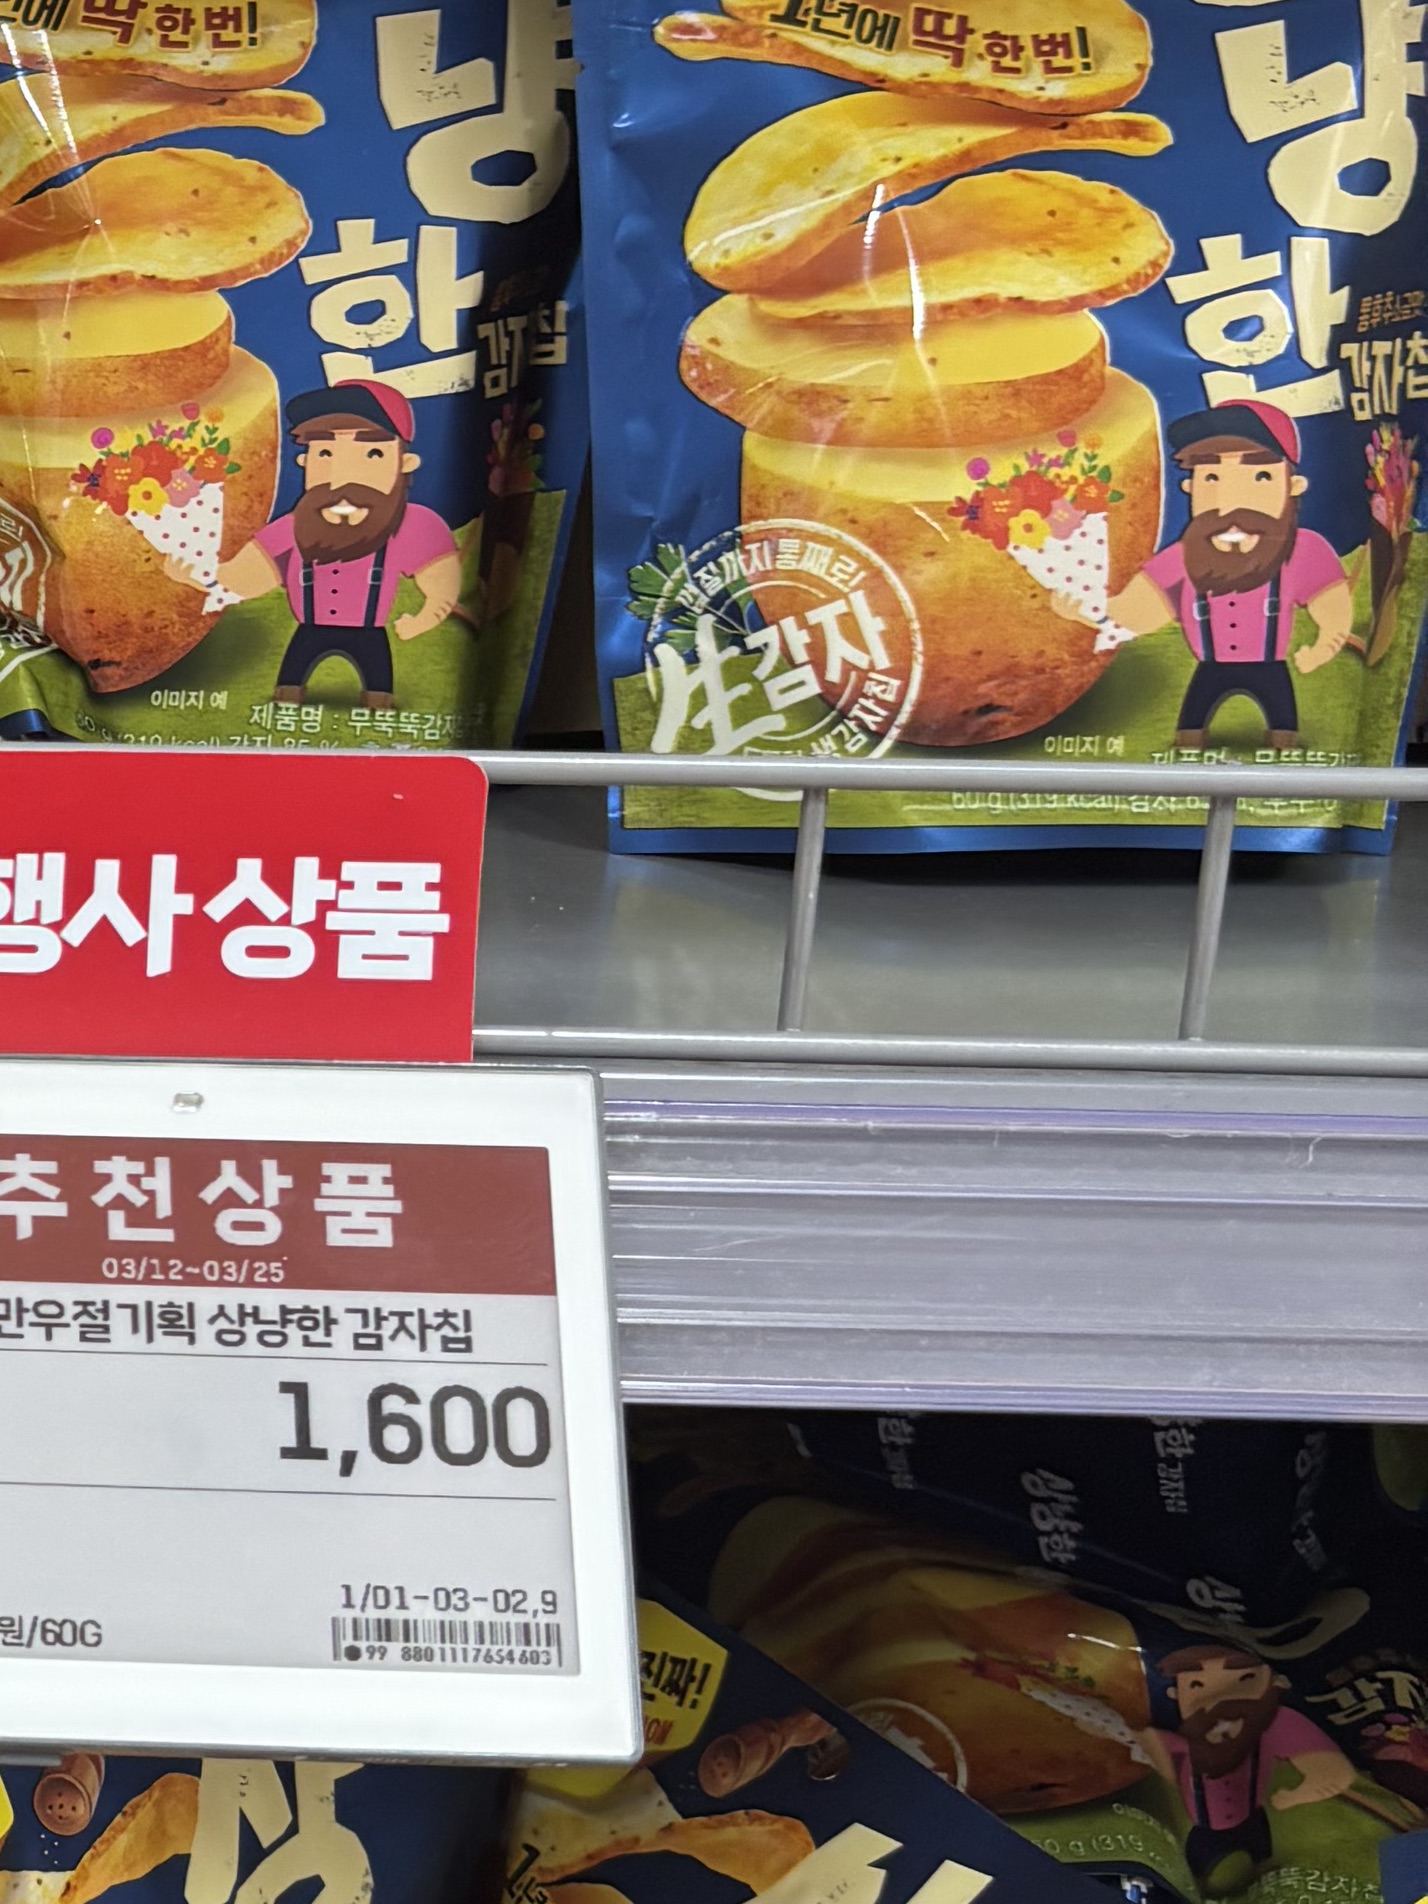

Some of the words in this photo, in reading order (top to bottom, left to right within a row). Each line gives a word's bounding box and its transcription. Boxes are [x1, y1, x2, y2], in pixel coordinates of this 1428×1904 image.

[155, 0, 259, 48] 한번!
[910, 5, 976, 69] 딱
[982, 27, 1091, 77] 한번!
[773, 537, 864, 593] 통째로!
[150, 690, 204, 710] 이미지
[210, 689, 228, 710] 예
[249, 704, 325, 734] 제품명
[1043, 735, 1101, 757] 이미지
[1105, 734, 1125, 757] 예
[102, 1258, 286, 1285] 03/12~03/25
[207, 1303, 340, 1350] 상냥한
[345, 1306, 473, 1354] 감자칩
[278, 1381, 552, 1477] 1,600
[365, 1646, 388, 1662] 99
